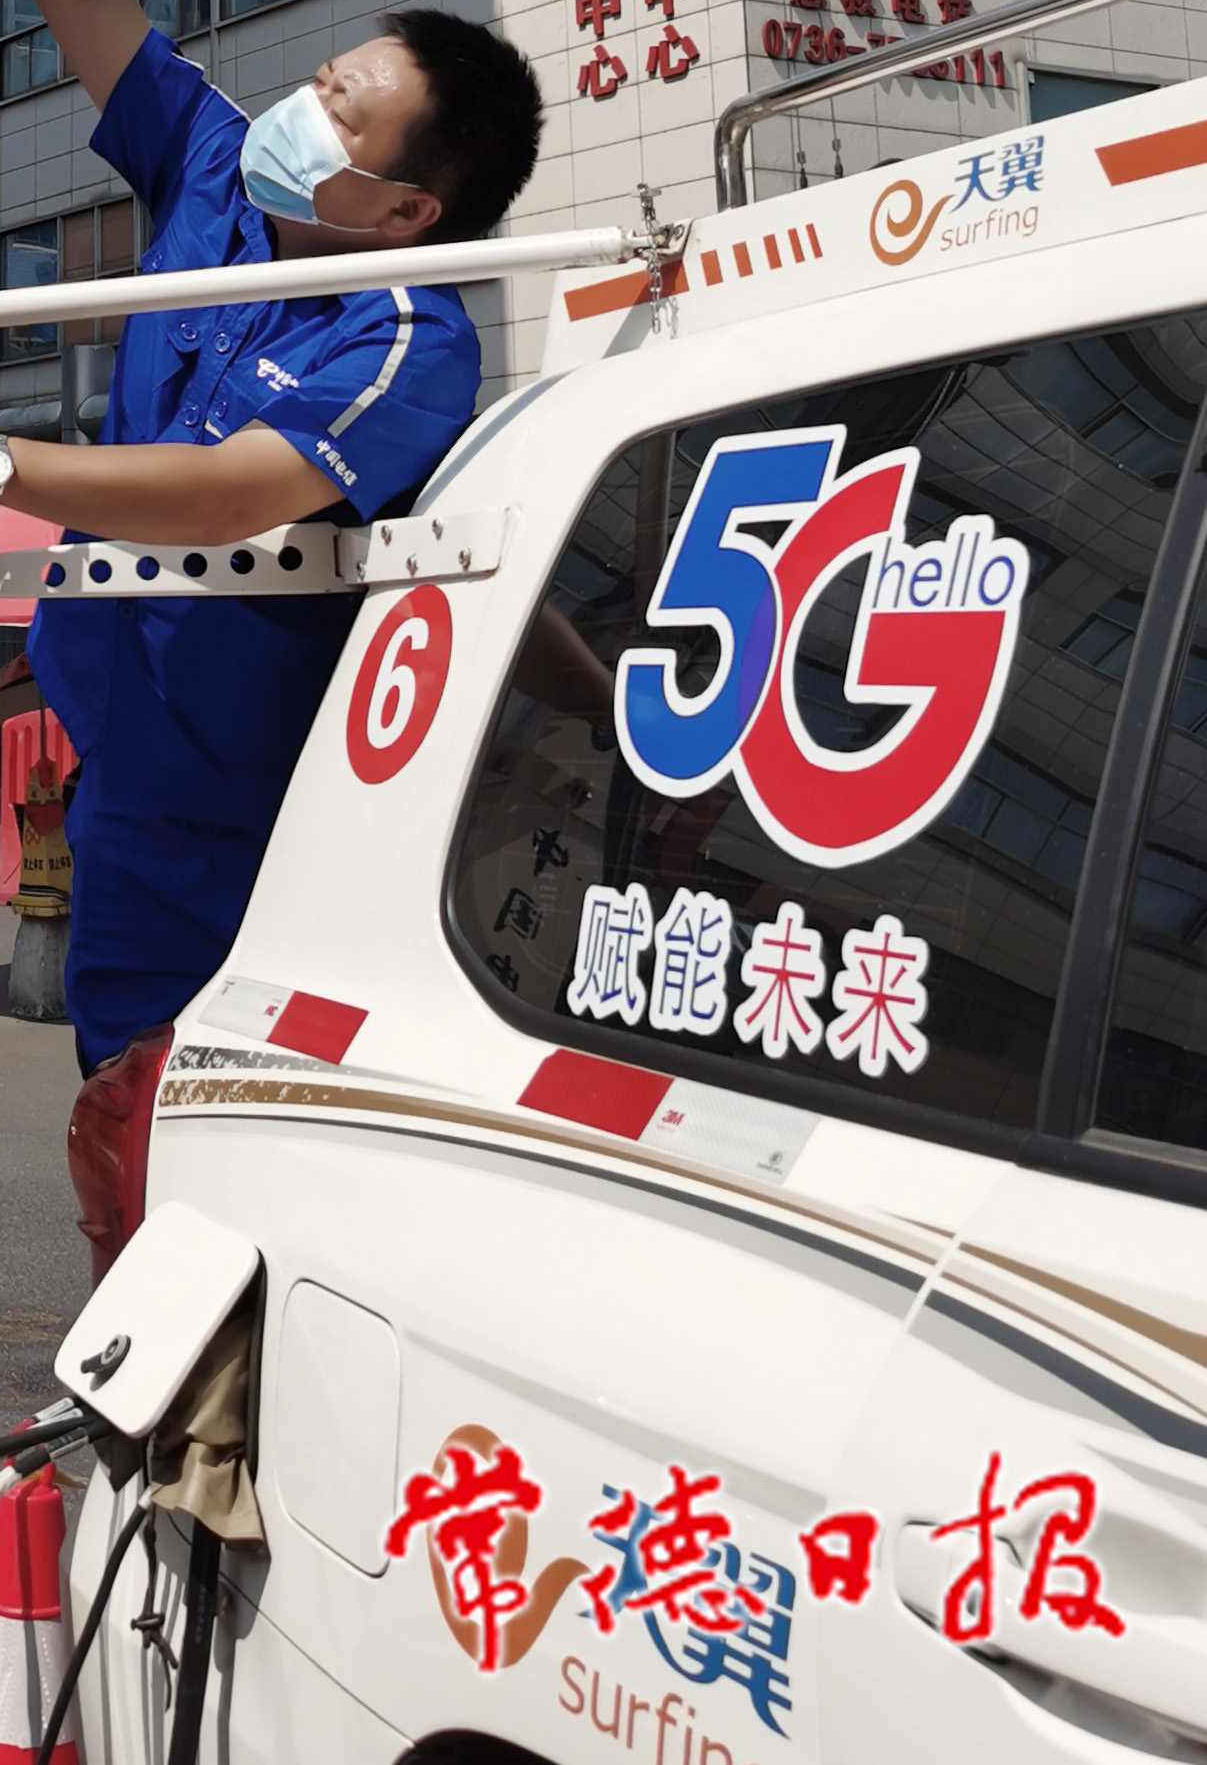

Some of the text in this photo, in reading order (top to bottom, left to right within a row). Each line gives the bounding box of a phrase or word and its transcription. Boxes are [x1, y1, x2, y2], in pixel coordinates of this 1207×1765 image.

[948, 135, 1044, 214] 天翼
[940, 206, 1039, 251] surfing
[316, 439, 358, 487] 中国电信
[871, 532, 1017, 610] hello
[367, 614, 429, 750] 6
[620, 432, 1007, 858] 5G
[576, 892, 922, 1066] 赋能未来
[558, 1655, 760, 1765] surfin
